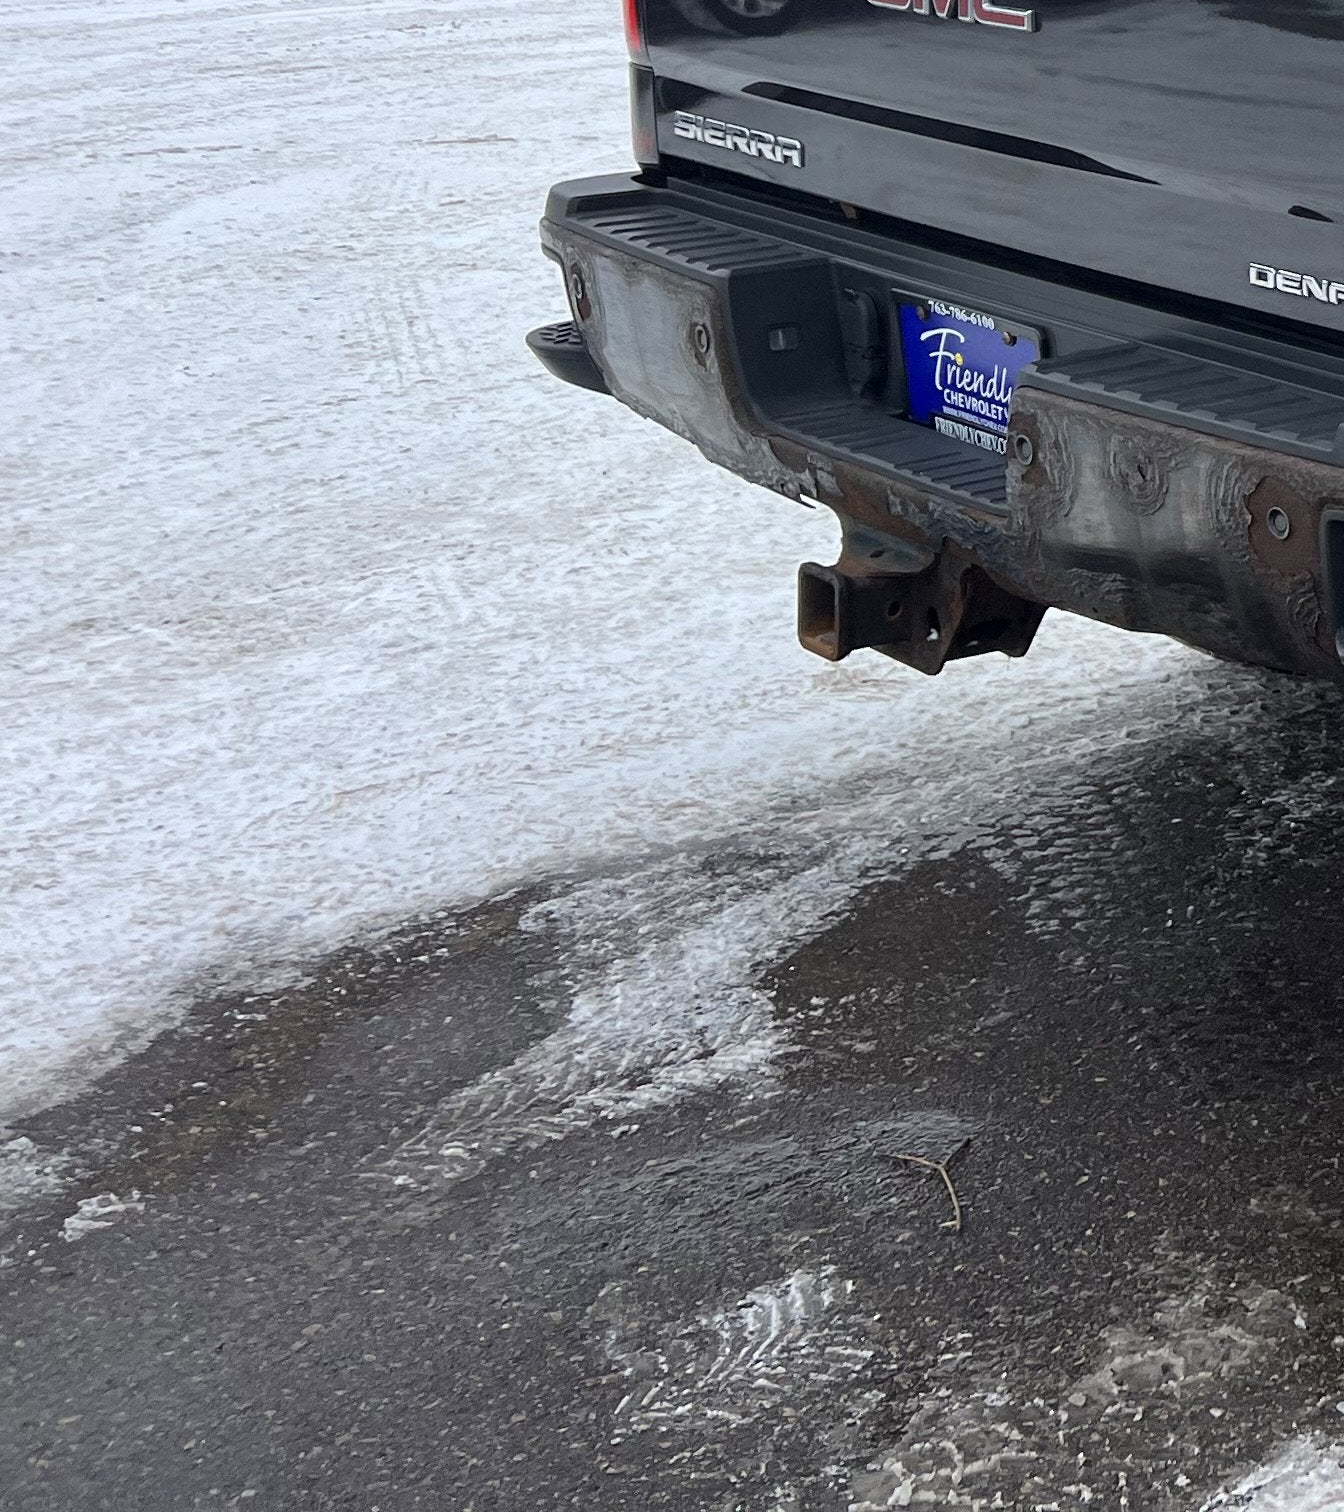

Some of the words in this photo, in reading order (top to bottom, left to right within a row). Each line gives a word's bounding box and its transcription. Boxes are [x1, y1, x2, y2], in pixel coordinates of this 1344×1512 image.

[673, 110, 805, 168] SIERRA
[928, 300, 995, 331] 763-786-6100
[944, 389, 1004, 421] CHEVROLET
[935, 417, 1008, 455] FRIENDLYCHEV.C
